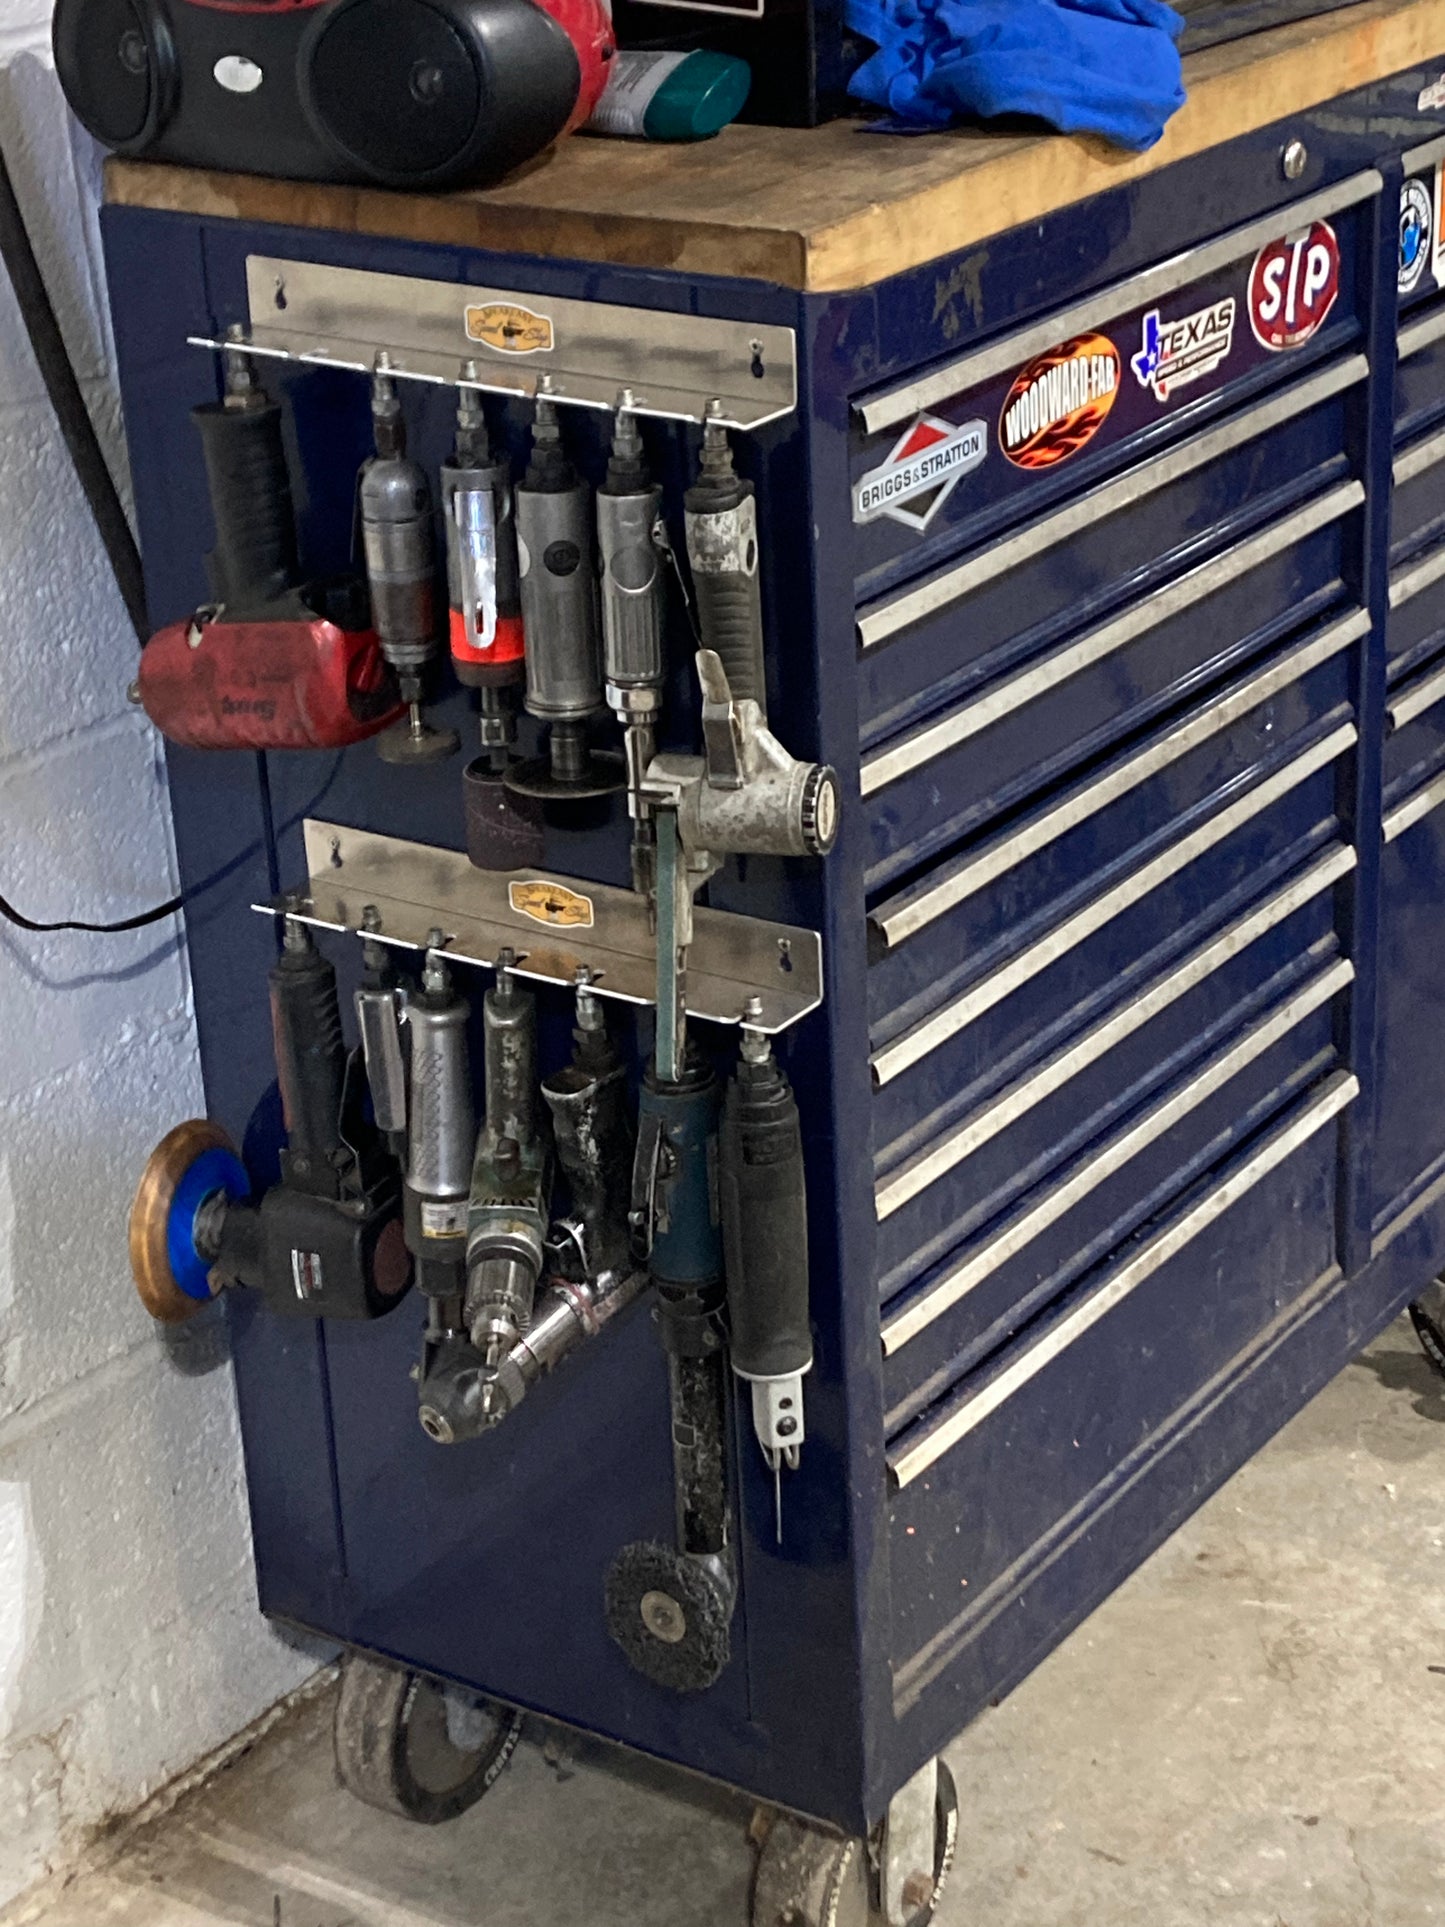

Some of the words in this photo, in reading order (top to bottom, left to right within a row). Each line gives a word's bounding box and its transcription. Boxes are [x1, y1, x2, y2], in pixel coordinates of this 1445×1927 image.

[1259, 227, 1330, 323] STP
[1157, 302, 1232, 361] TEXAS
[1005, 354, 1115, 448] WOODWARD-FAB
